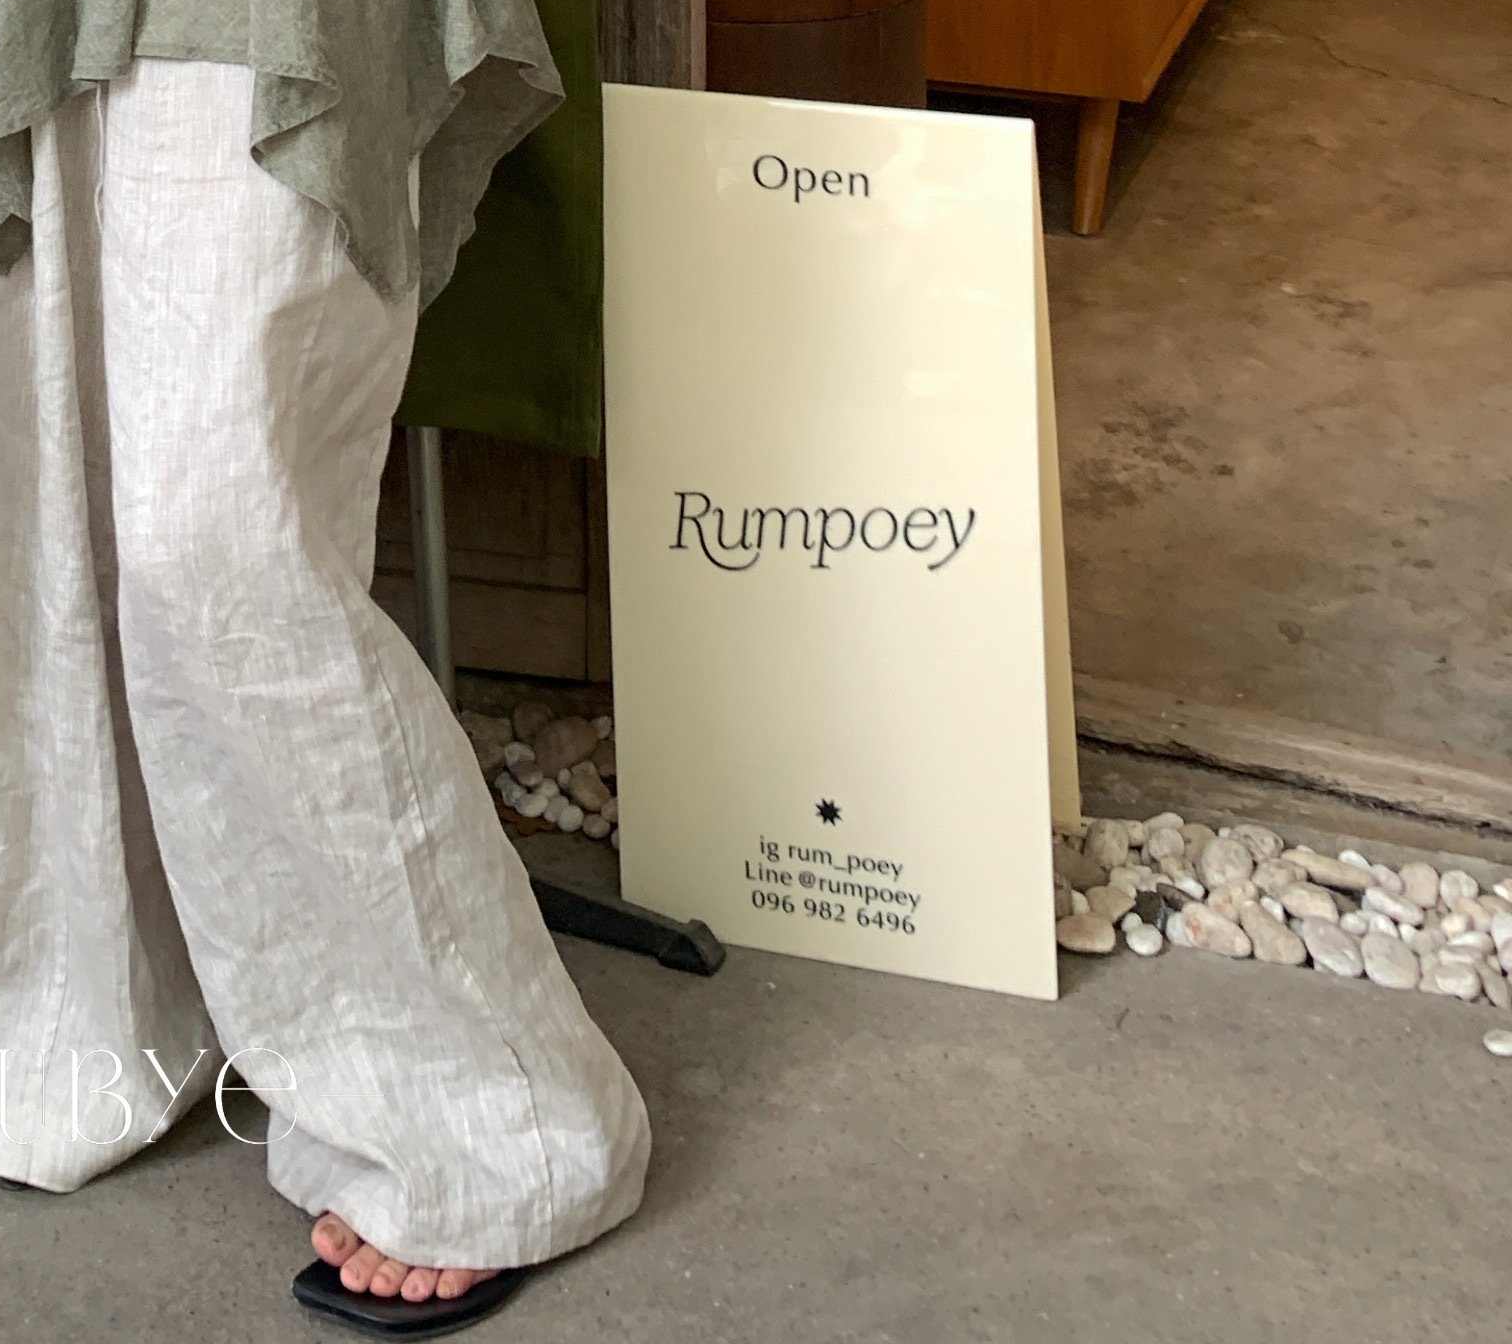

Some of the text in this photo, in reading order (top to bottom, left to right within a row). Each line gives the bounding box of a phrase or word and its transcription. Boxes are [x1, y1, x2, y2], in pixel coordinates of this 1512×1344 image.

[752, 154, 871, 203] Open
[669, 491, 976, 571] Rumpoey
[759, 835, 903, 881] ig rum_poey
[744, 861, 921, 912] Line @rumpoey
[751, 889, 916, 935] 096 982 6496
